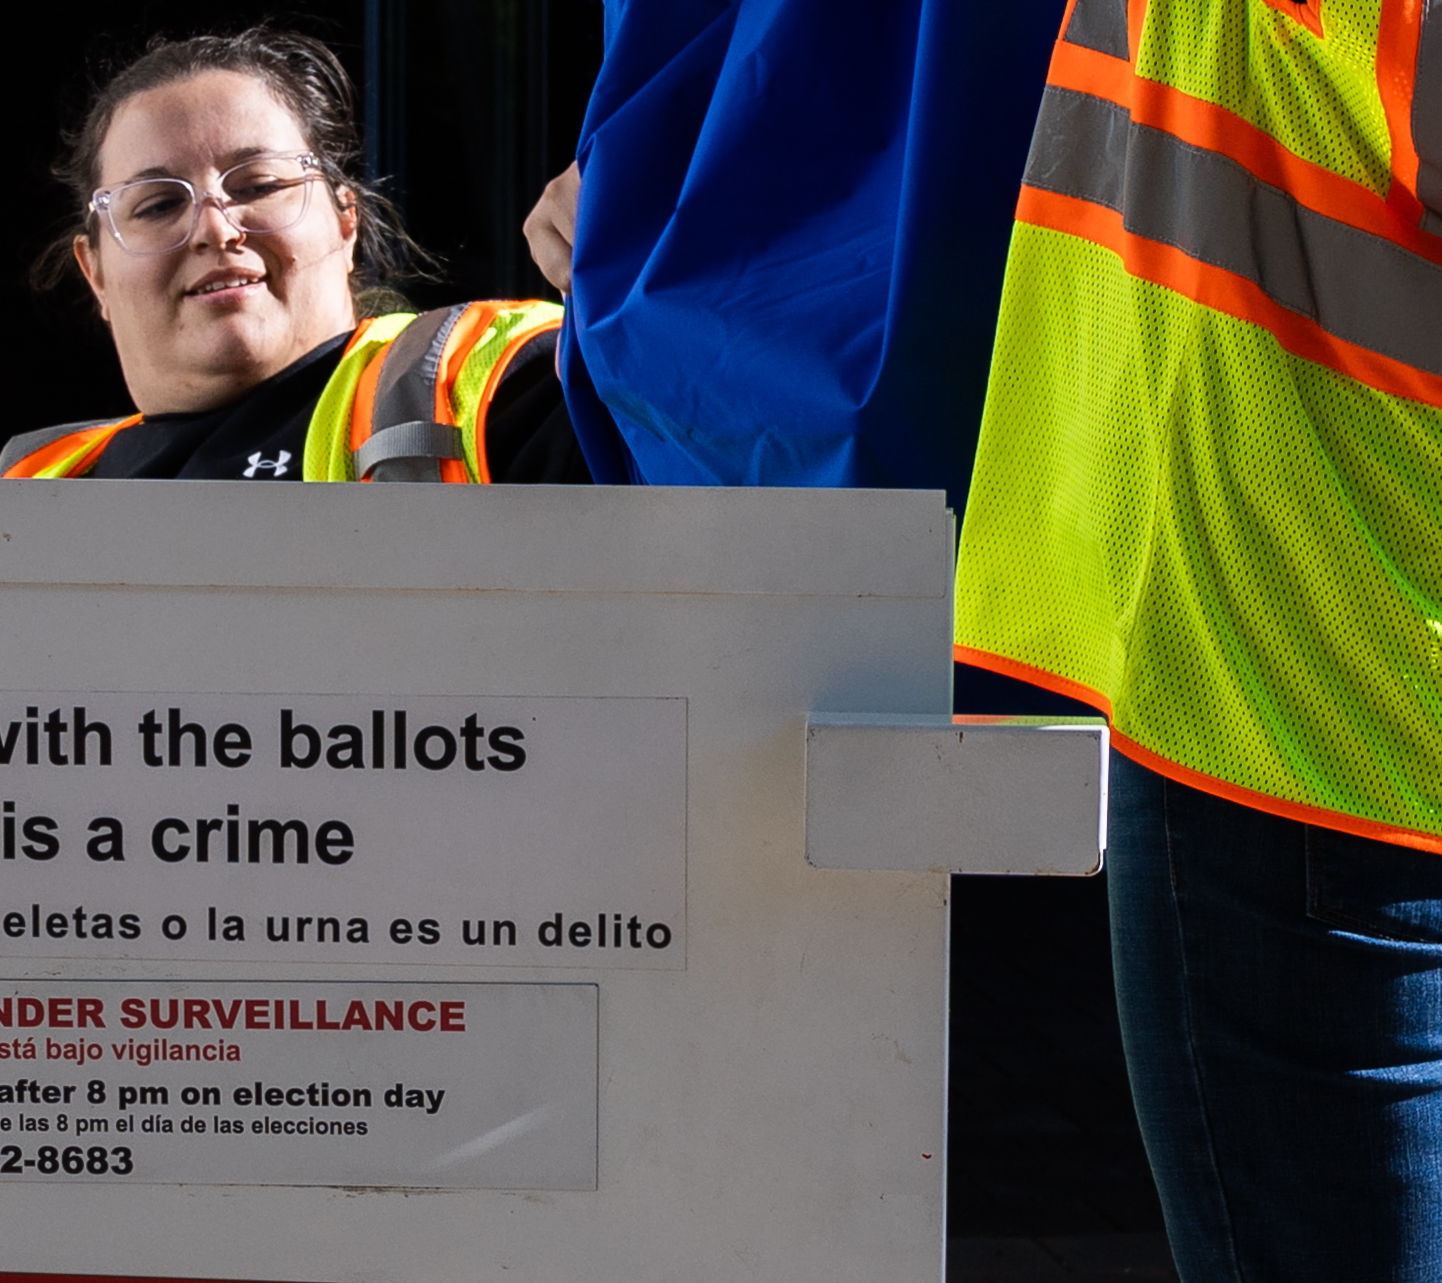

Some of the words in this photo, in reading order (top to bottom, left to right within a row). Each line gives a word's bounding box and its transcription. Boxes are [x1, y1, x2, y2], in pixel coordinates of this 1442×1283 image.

[139, 708, 252, 768] the
[281, 709, 526, 771] ballots
[4, 801, 59, 860] is
[87, 817, 125, 861] a
[152, 804, 354, 865] crime
[162, 915, 186, 940] o
[209, 907, 245, 941] la
[267, 917, 369, 943] urna
[390, 919, 440, 944] es
[463, 920, 516, 945] un
[538, 913, 671, 949] delito
[121, 999, 465, 1031] SURVEILLANCE
[47, 1038, 102, 1065] bajo
[112, 1039, 240, 1066] vigilancia
[87, 1080, 106, 1104] 8
[119, 1087, 168, 1110] pm
[181, 1087, 220, 1105] on
[234, 1082, 371, 1107] election
[384, 1084, 445, 1114] day
[20, 1114, 49, 1131] las
[57, 1114, 68, 1131] 8
[76, 1119, 108, 1136] pm
[116, 1115, 133, 1132] el
[142, 1115, 173, 1133] día
[181, 1116, 206, 1133] de
[214, 1116, 244, 1133] las
[252, 1116, 367, 1135] elecciones
